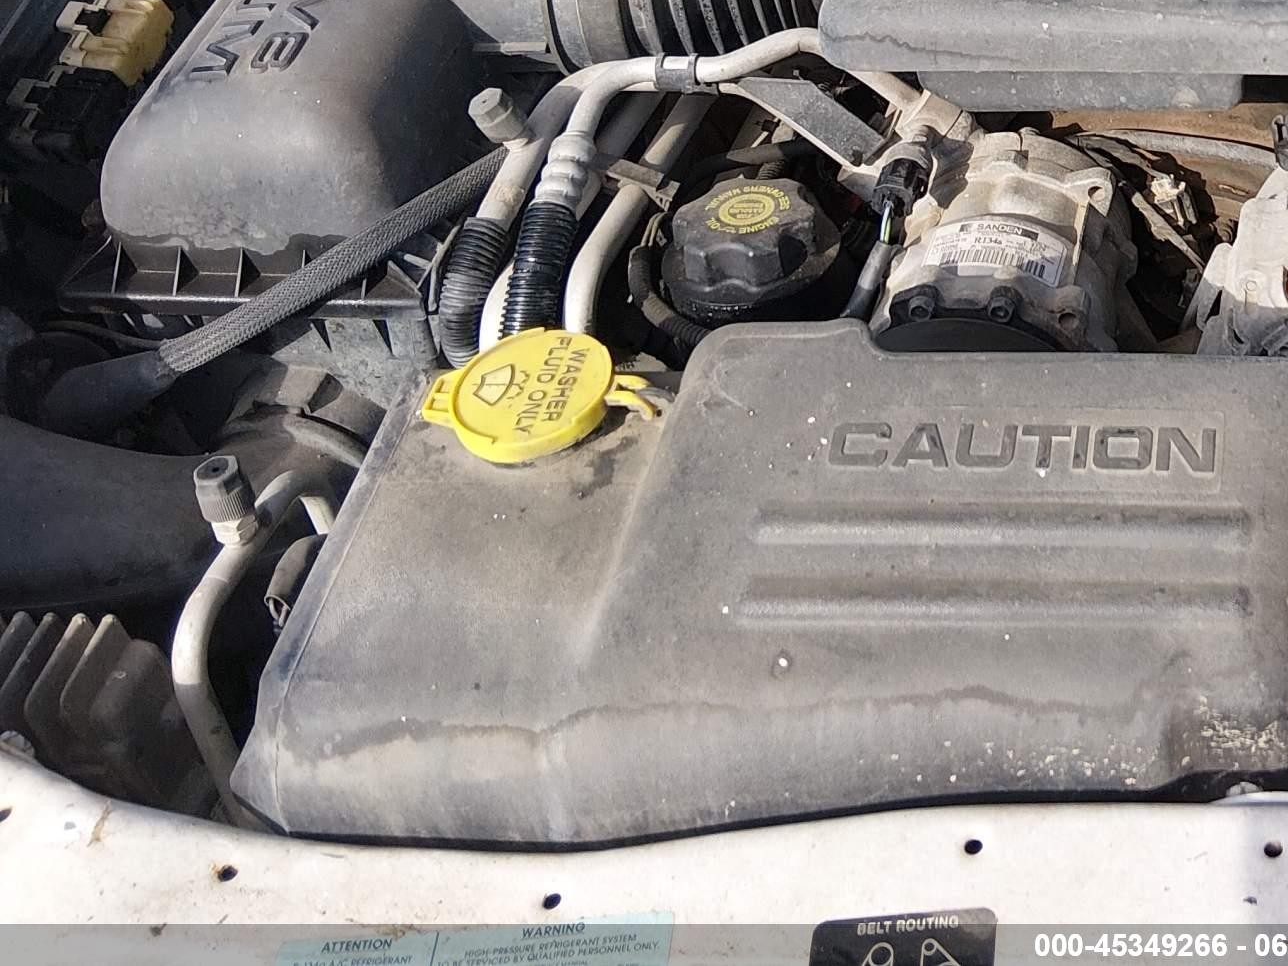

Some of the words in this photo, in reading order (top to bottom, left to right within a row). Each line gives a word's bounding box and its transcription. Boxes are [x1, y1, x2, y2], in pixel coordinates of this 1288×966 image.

[977, 223, 1023, 235] SANDEN
[536, 336, 572, 385] FLUID
[541, 347, 590, 423] WASHER
[514, 389, 548, 434] ONLY
[828, 422, 1216, 472] CAUTION
[521, 922, 586, 938] WARNING
[857, 921, 892, 935] BELT
[896, 915, 959, 932] ROUTING
[321, 938, 393, 953] ATTENTION
[602, 933, 638, 945] SYSTEM
[578, 944, 631, 956] PERSONNEL
